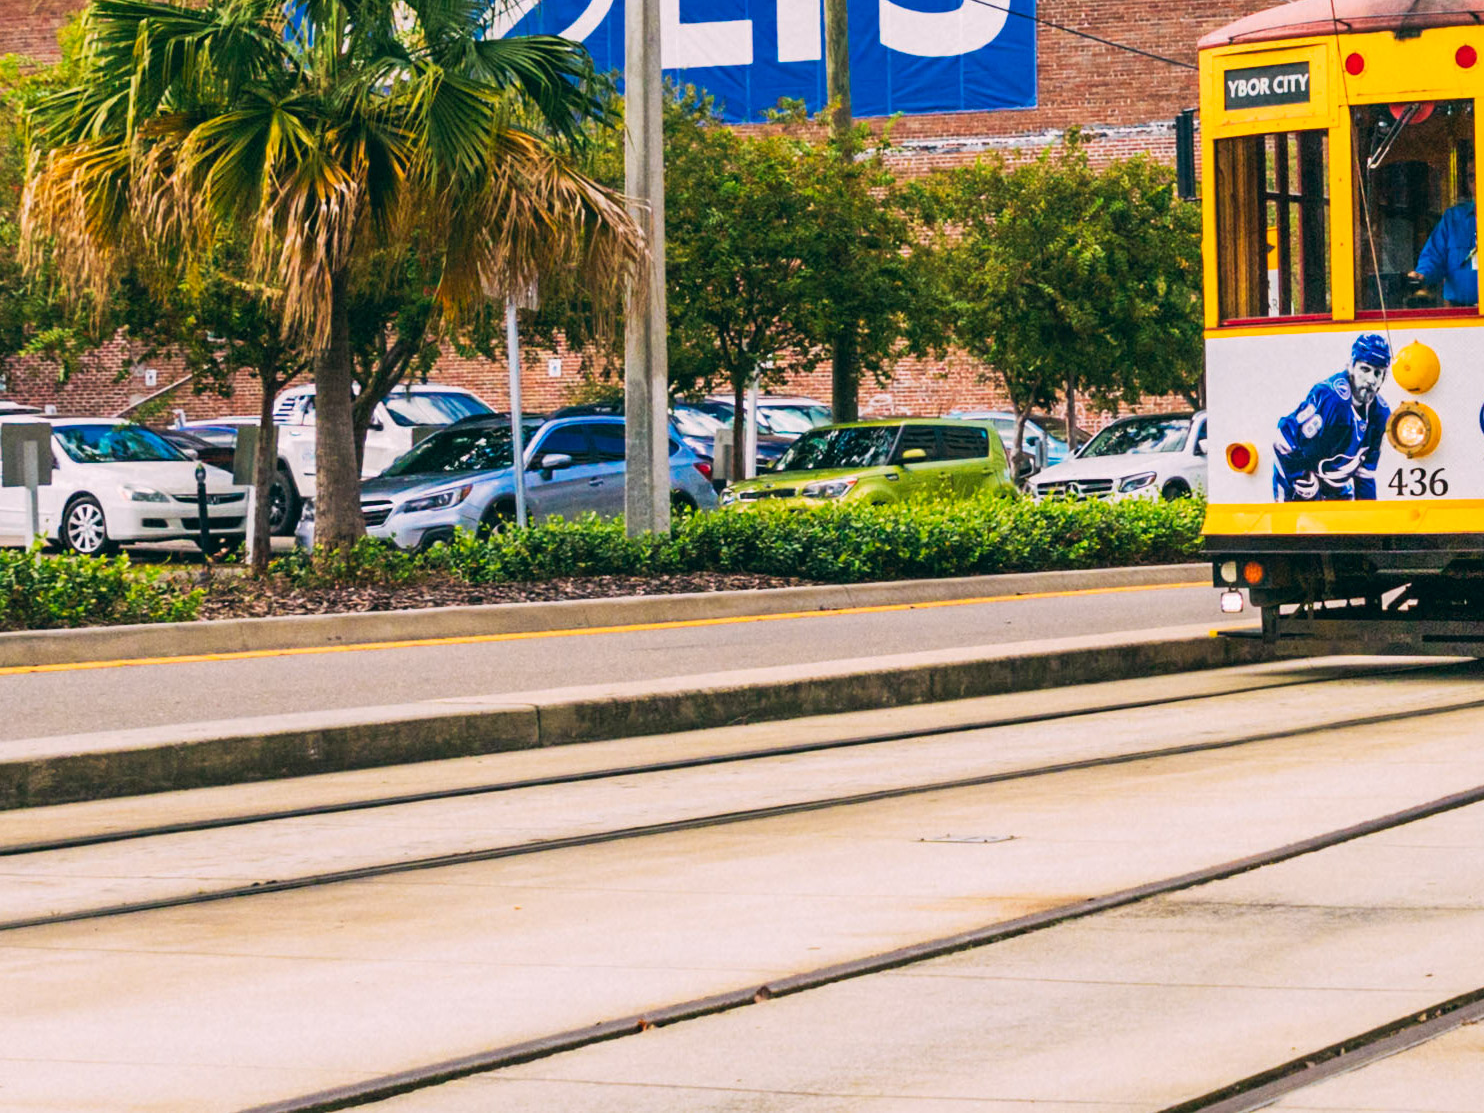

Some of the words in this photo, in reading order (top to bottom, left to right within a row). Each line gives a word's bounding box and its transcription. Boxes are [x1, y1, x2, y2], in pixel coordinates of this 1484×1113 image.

[1227, 77, 1271, 99] YBOR
[1272, 73, 1310, 94] CITY
[1387, 467, 1449, 497] 436
